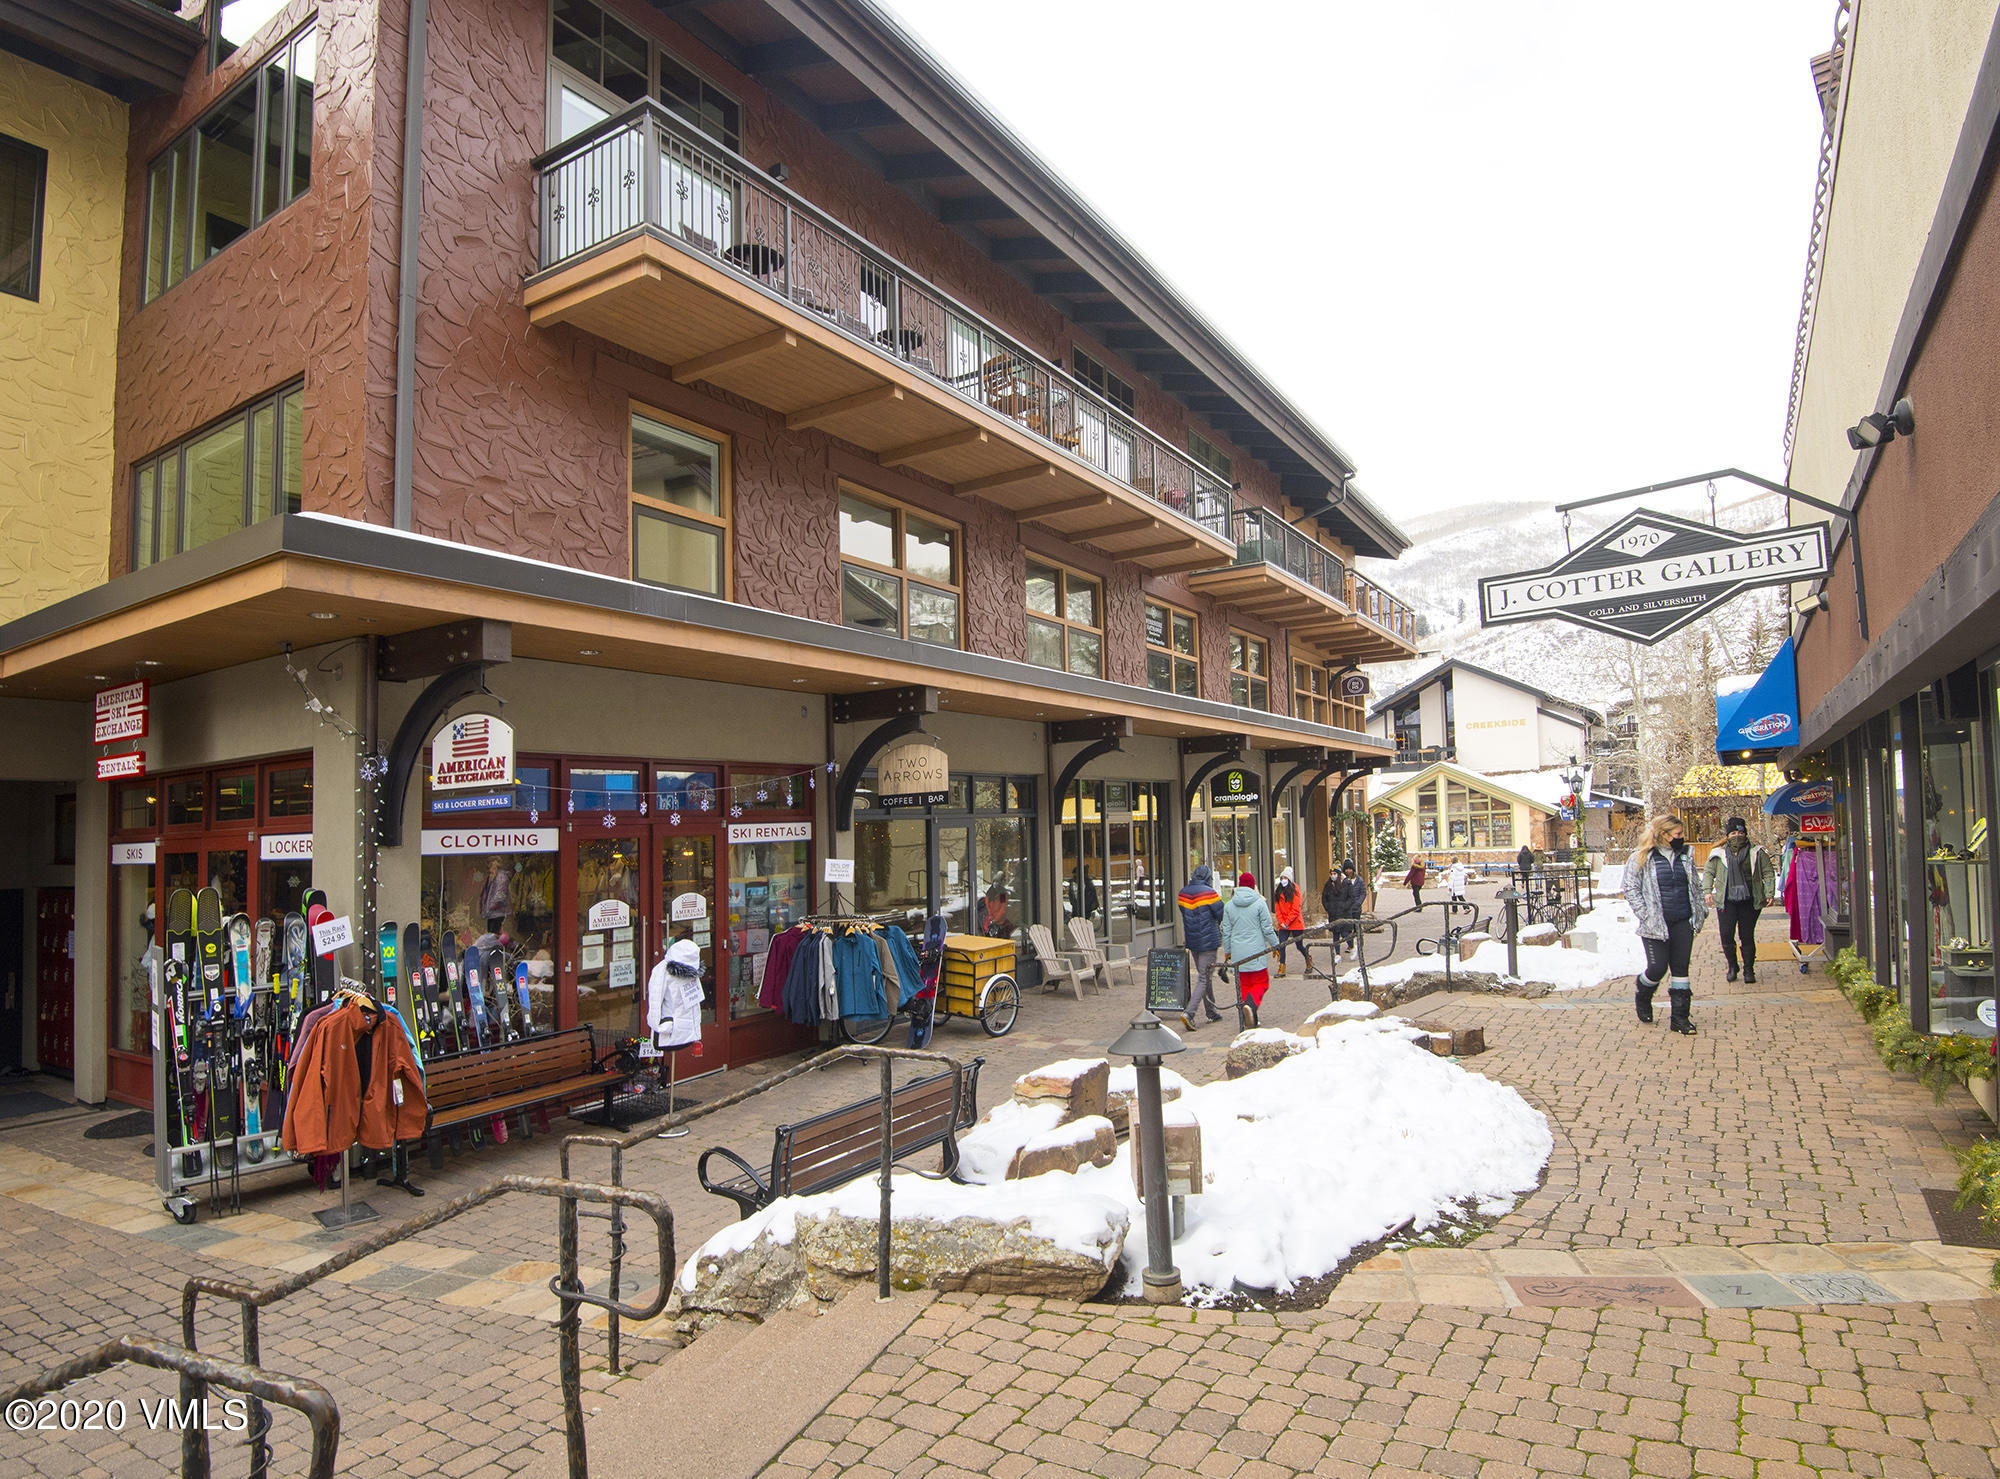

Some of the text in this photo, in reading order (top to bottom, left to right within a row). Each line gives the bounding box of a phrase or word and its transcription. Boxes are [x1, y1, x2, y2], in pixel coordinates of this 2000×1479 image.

[1619, 532, 1660, 549] 1970
[1500, 541, 1808, 610] J. COTTER GALLERY
[1588, 594, 1707, 617] GOLD AND SILVERSMITH
[97, 688, 142, 708] AMERICAN
[110, 706, 127, 720] SKI
[96, 718, 142, 738] EXCHANGE
[1465, 718, 1527, 730] CREEKSIDE
[100, 760, 137, 775] RENTALS
[438, 757, 506, 774] AMERICAN
[898, 757, 927, 768] TWO
[437, 770, 505, 785] SKI EXCHANGE
[884, 770, 942, 781] ARROWS
[433, 802, 444, 810] SKI
[451, 799, 477, 809] LOCKER
[478, 797, 508, 807] RENTALS
[883, 795, 944, 805] COFFEE BAR
[732, 825, 807, 839] SKI RENTALS
[269, 839, 313, 854] LOCKER
[441, 834, 538, 848] CLOTHING
[126, 848, 143, 861] SKIS
[592, 915, 627, 923] AMERICAN
[319, 928, 331, 937] This
[322, 932, 346, 946] $24.95
